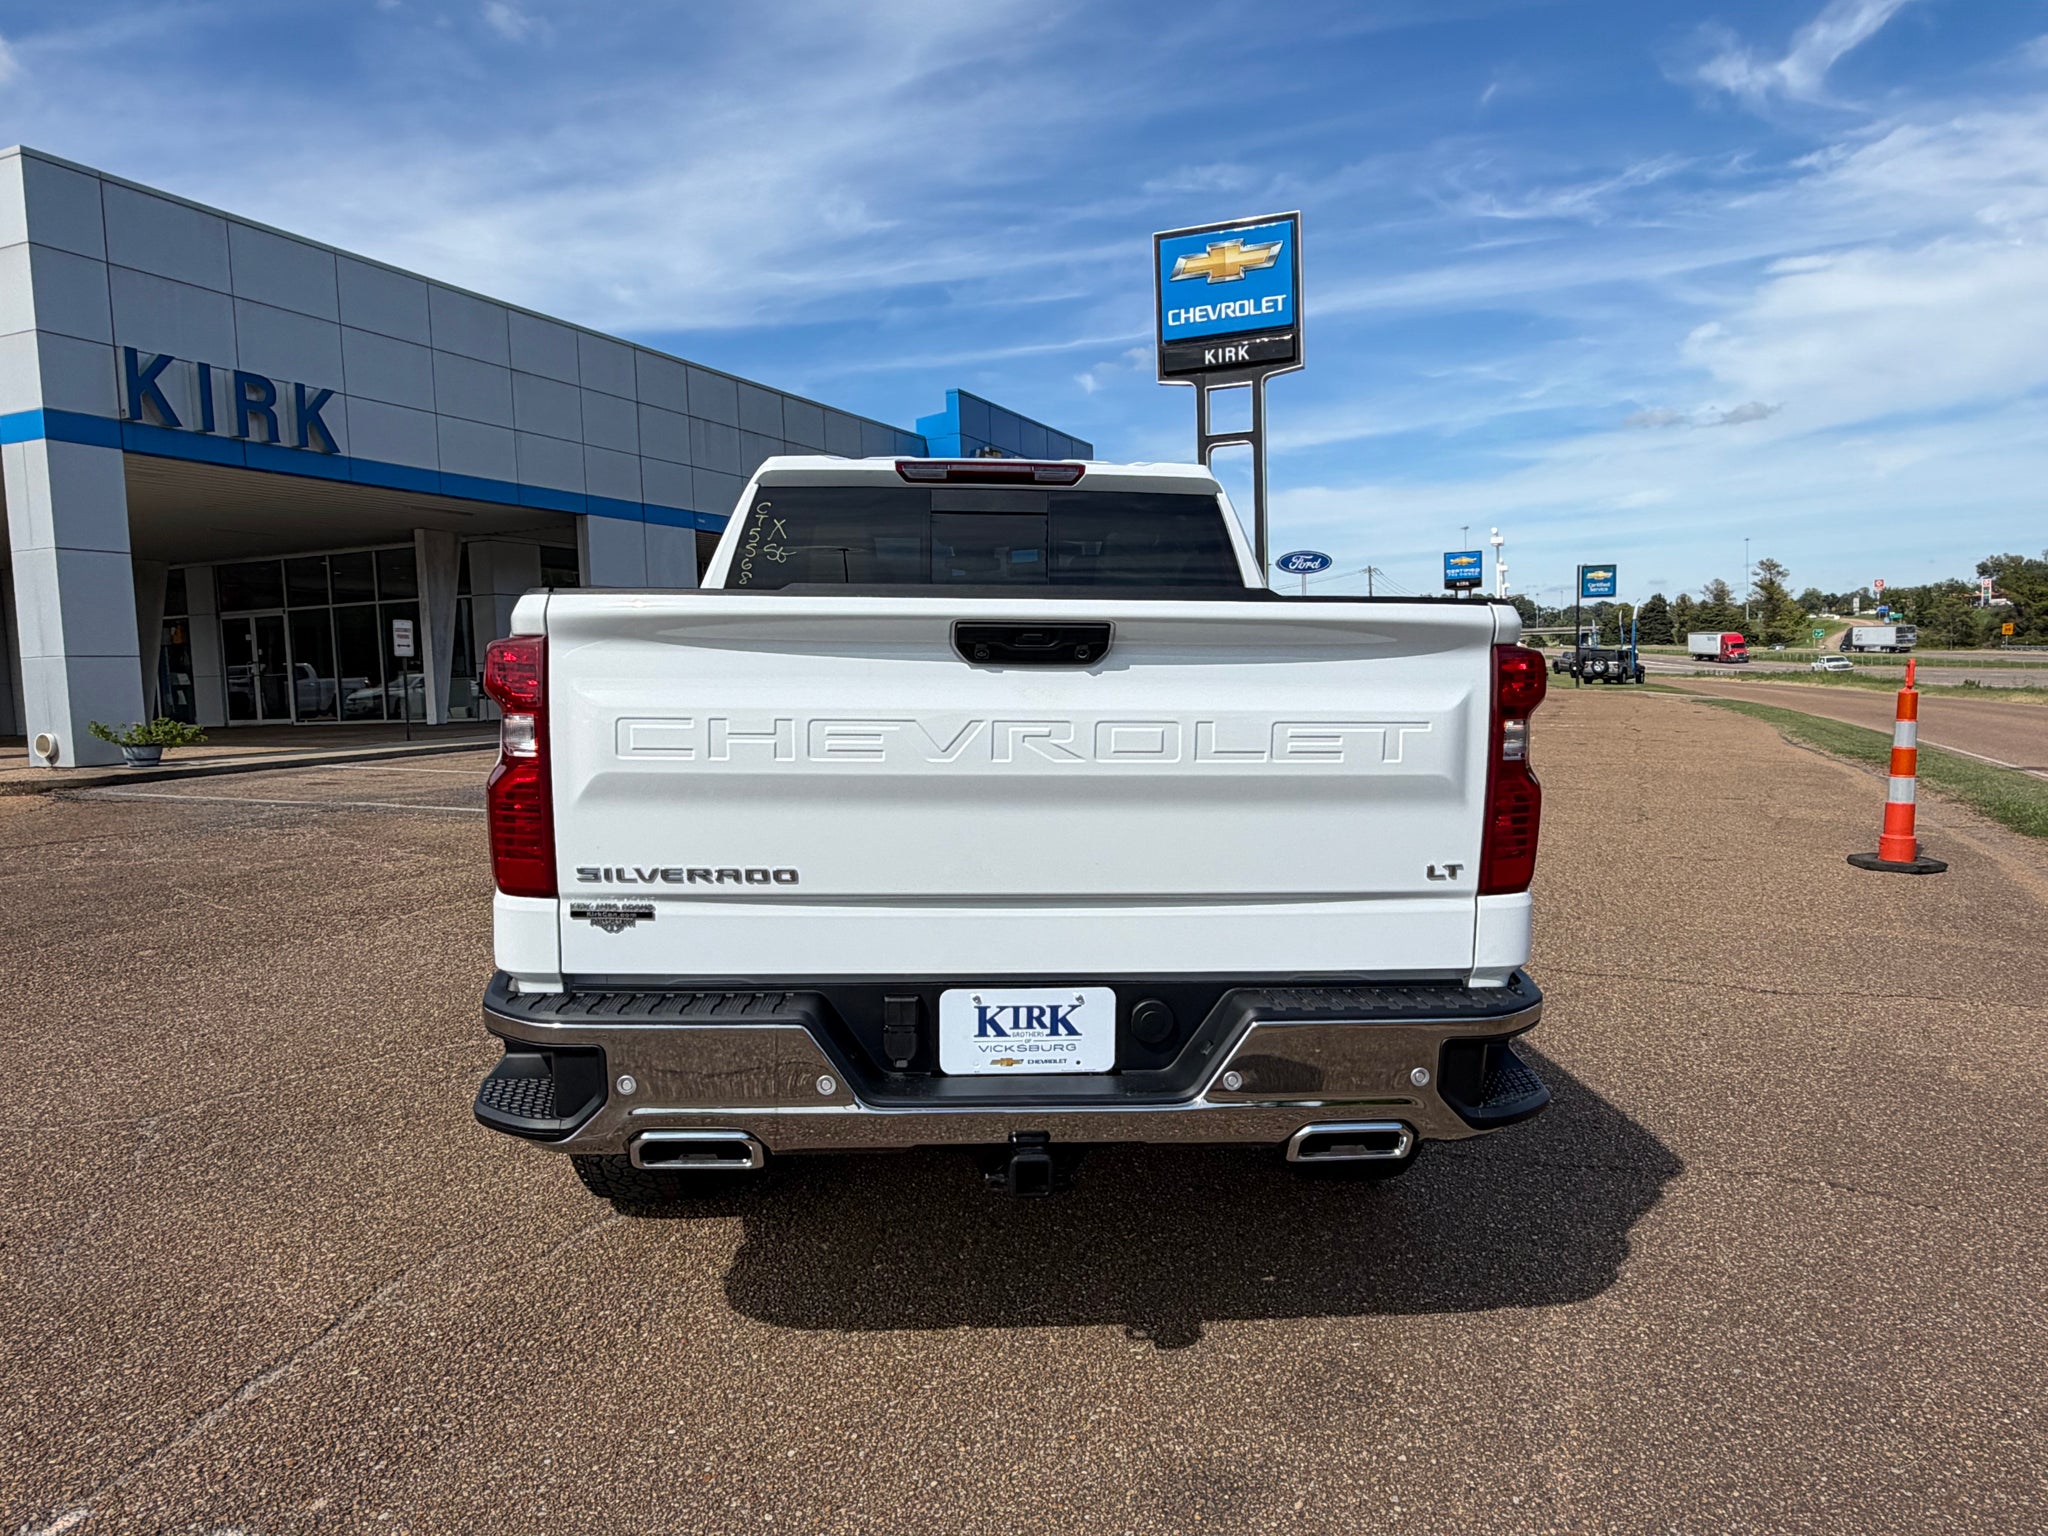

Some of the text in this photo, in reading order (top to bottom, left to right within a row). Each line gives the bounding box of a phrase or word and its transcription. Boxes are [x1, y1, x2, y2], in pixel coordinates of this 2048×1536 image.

[1168, 294, 1287, 326] CHEVROLET
[1205, 345, 1250, 365] KIRK
[121, 346, 341, 454] KIRK
[1288, 554, 1322, 570] Ford
[615, 717, 1433, 763] CHEVROLET
[576, 866, 799, 884] SILVERADO
[1426, 864, 1464, 881] LT
[974, 1005, 1082, 1037] KIRK
[978, 1043, 1077, 1053] VICKSBURG
